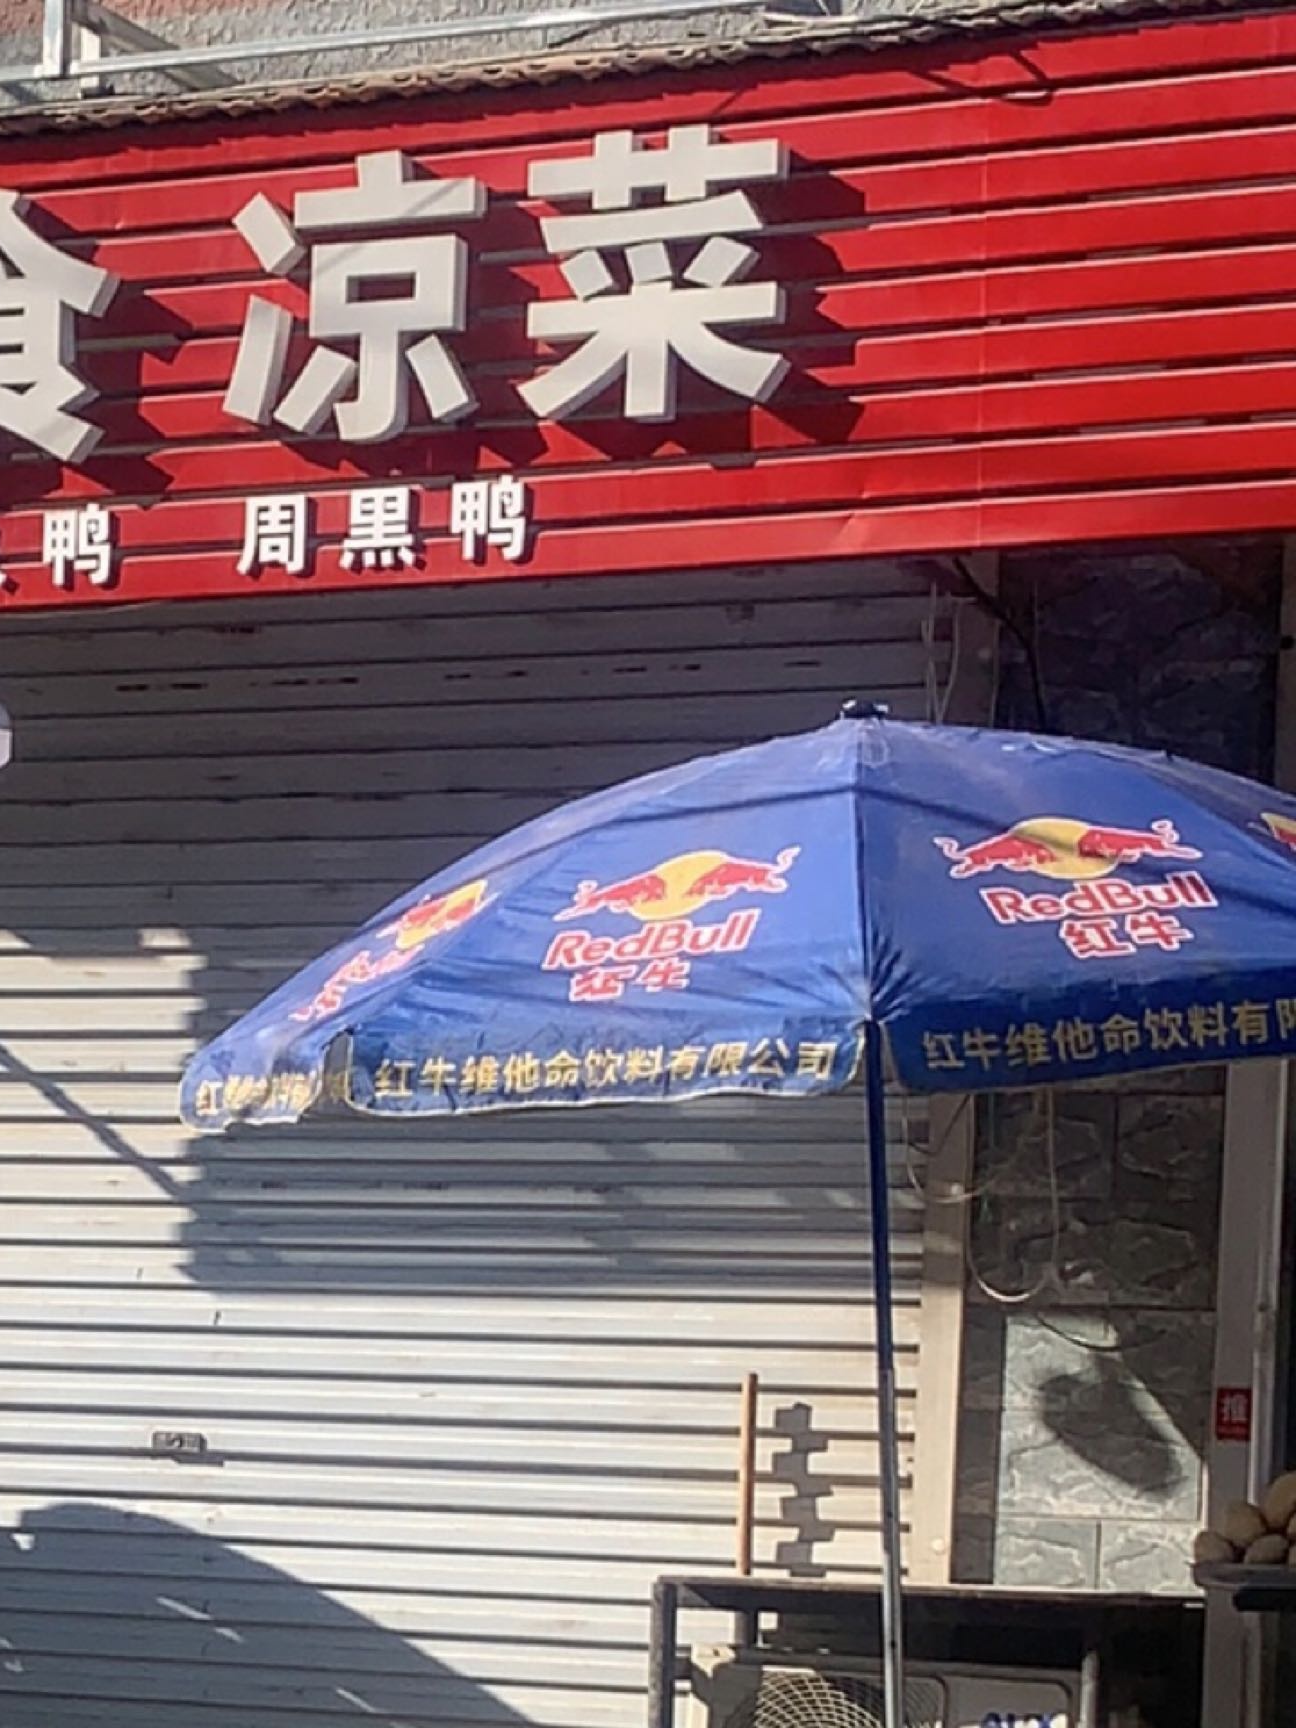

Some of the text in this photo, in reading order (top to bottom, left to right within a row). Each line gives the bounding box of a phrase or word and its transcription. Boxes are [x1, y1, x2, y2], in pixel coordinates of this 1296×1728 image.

[224, 125, 793, 443] 凉菜
[979, 871, 1218, 925] RedBull
[542, 909, 761, 970] RedBull
[1059, 911, 1194, 959] 红牛
[375, 1037, 840, 1097] 红牛维他命饮料有限公司
